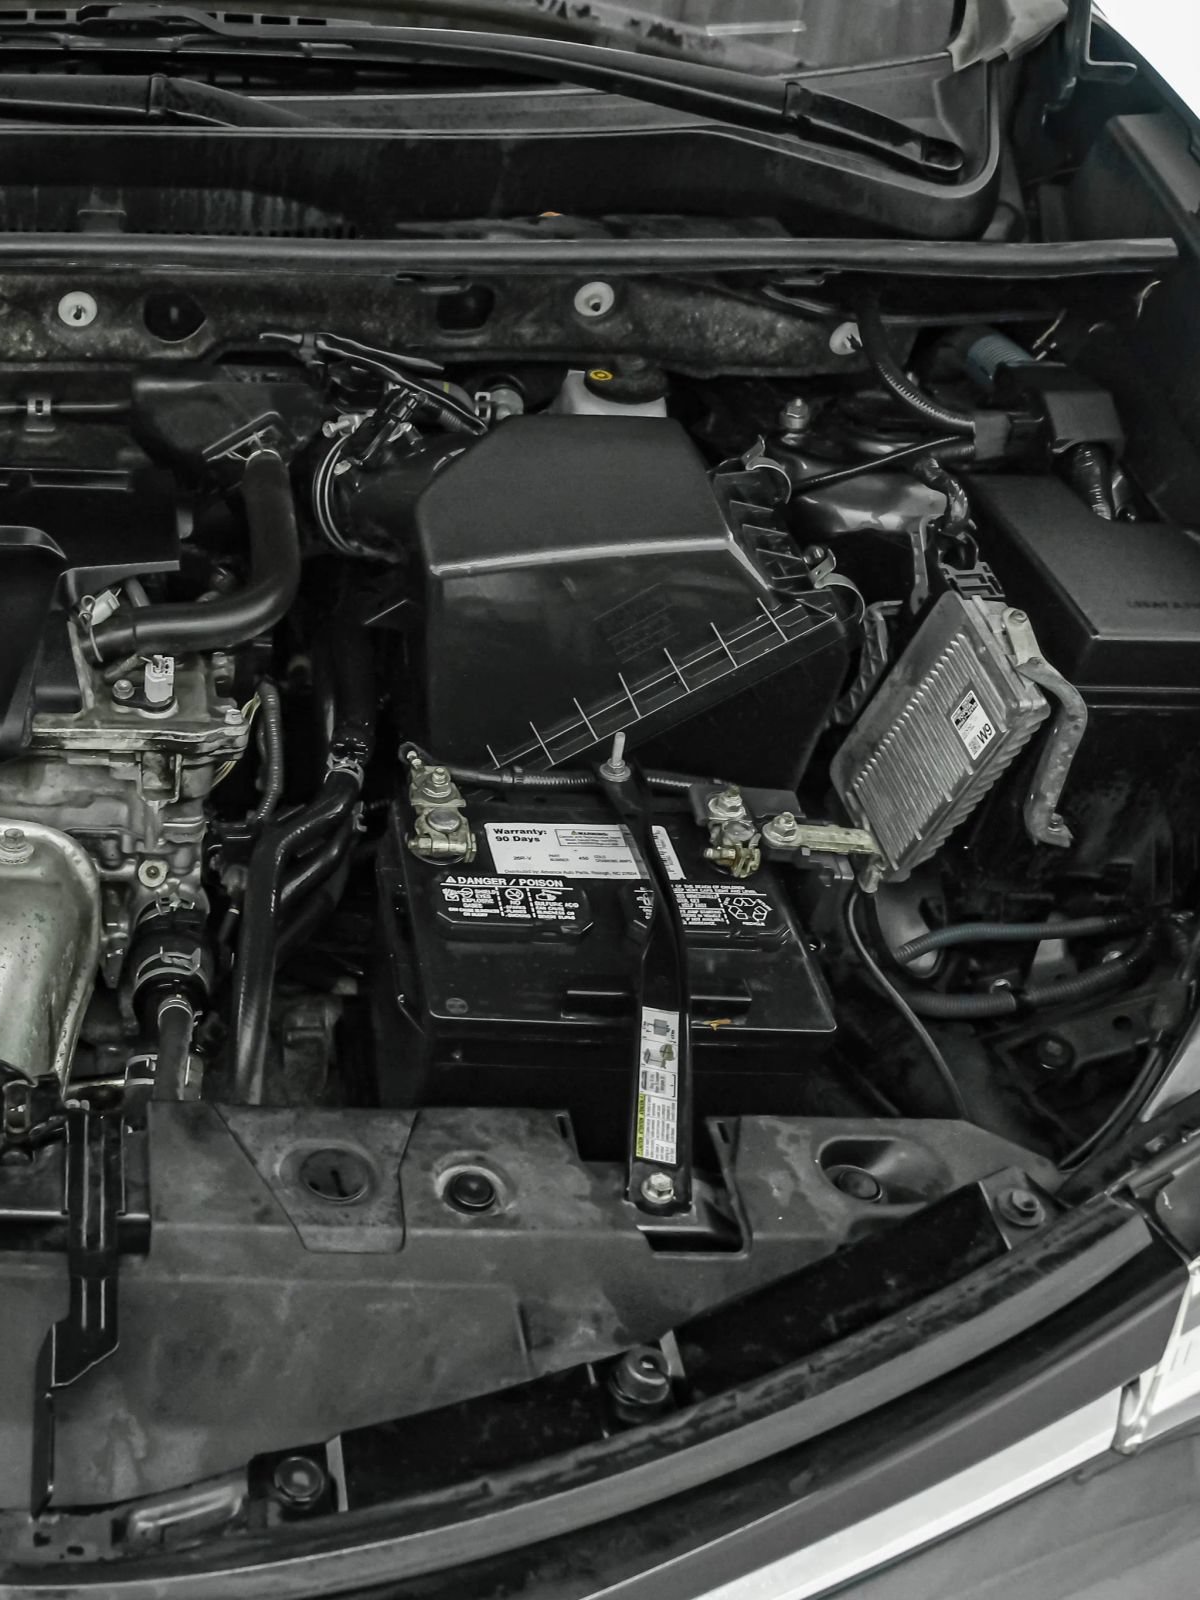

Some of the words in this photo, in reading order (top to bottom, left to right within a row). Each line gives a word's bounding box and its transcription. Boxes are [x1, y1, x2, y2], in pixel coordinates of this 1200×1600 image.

[976, 723, 993, 745] W9
[493, 828, 547, 836] Warranty:
[457, 876, 507, 886] DANGER
[519, 878, 564, 888] POISON
